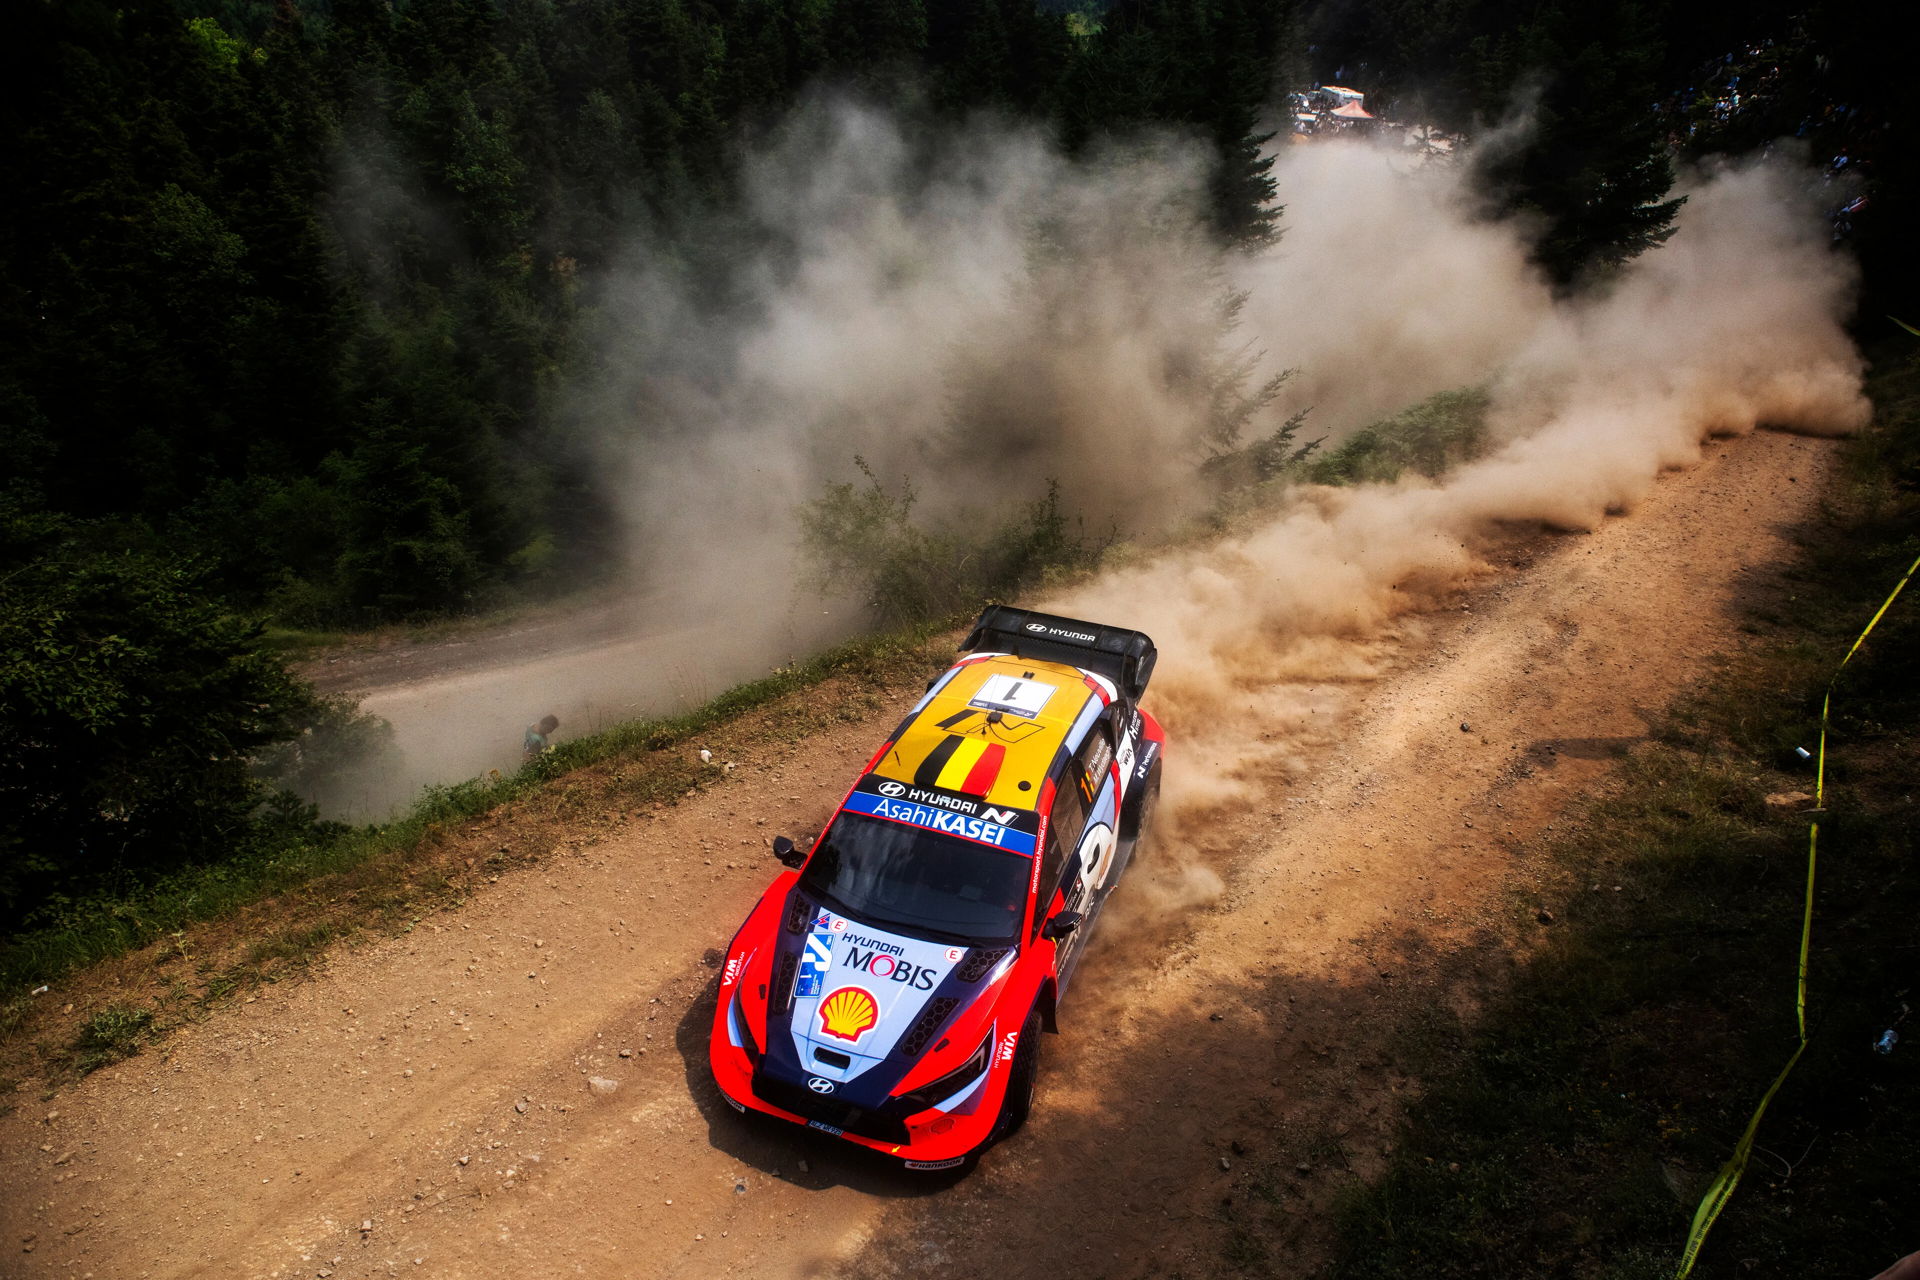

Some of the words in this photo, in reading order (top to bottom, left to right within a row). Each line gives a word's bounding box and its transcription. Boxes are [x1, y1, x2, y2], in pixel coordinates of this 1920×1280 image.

[1002, 682, 1023, 701] 1
[908, 788, 978, 814] HYUNDAI
[1081, 777, 1093, 803] 1
[1032, 815, 1048, 894] motorsport.hyundai.com
[834, 921, 844, 930] E
[842, 933, 905, 957] HYUNDAI
[949, 950, 957, 959] E
[842, 947, 937, 991] MOBIS
